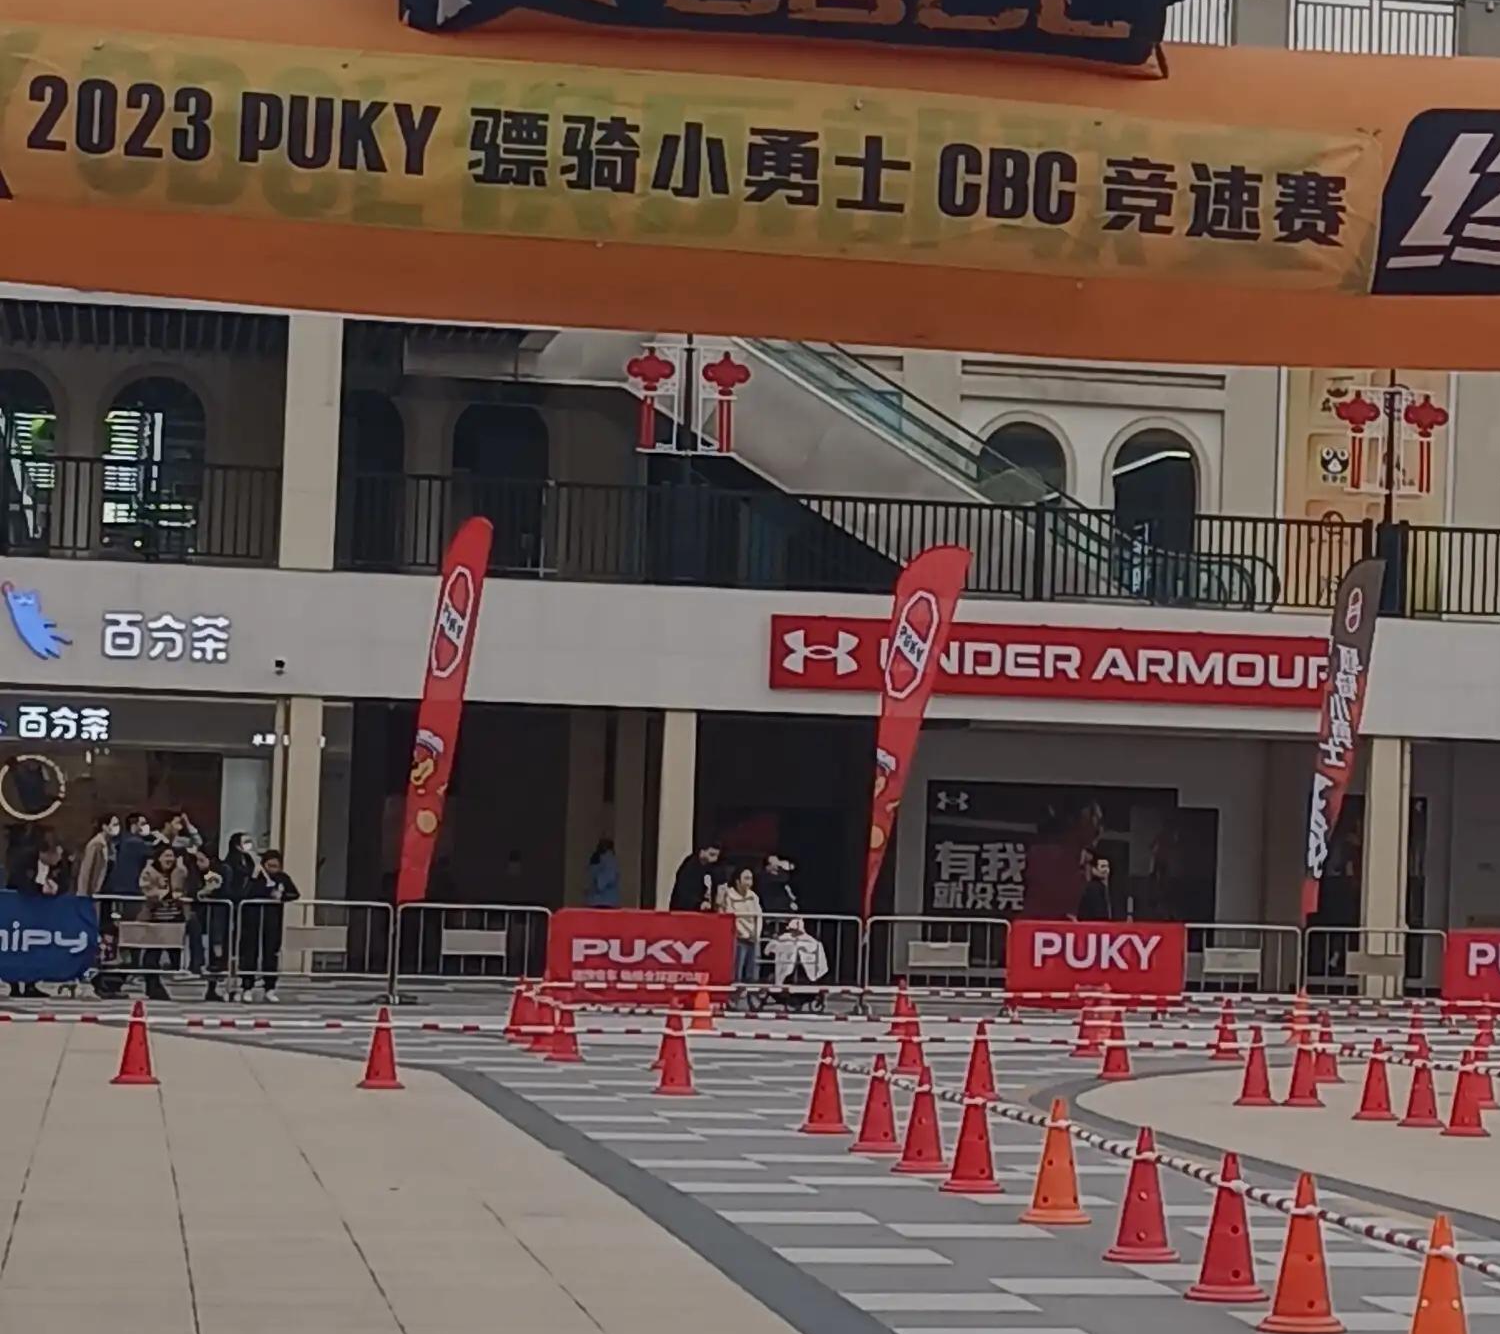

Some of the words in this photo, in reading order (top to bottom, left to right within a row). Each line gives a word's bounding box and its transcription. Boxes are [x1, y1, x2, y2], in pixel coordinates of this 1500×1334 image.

[27, 74, 213, 162] 2023
[238, 91, 441, 176] PUKY
[467, 107, 912, 214] 骠骑小勇士
[937, 141, 1077, 225] CBC
[1101, 154, 1347, 247] 竞速赛
[103, 612, 230, 661] 百分茶
[18, 705, 111, 742] 百分茶
[935, 841, 1026, 882] 有我
[933, 881, 1025, 910] 就没完
[572, 938, 710, 964] PUKY
[1034, 931, 1162, 970] PUKY
